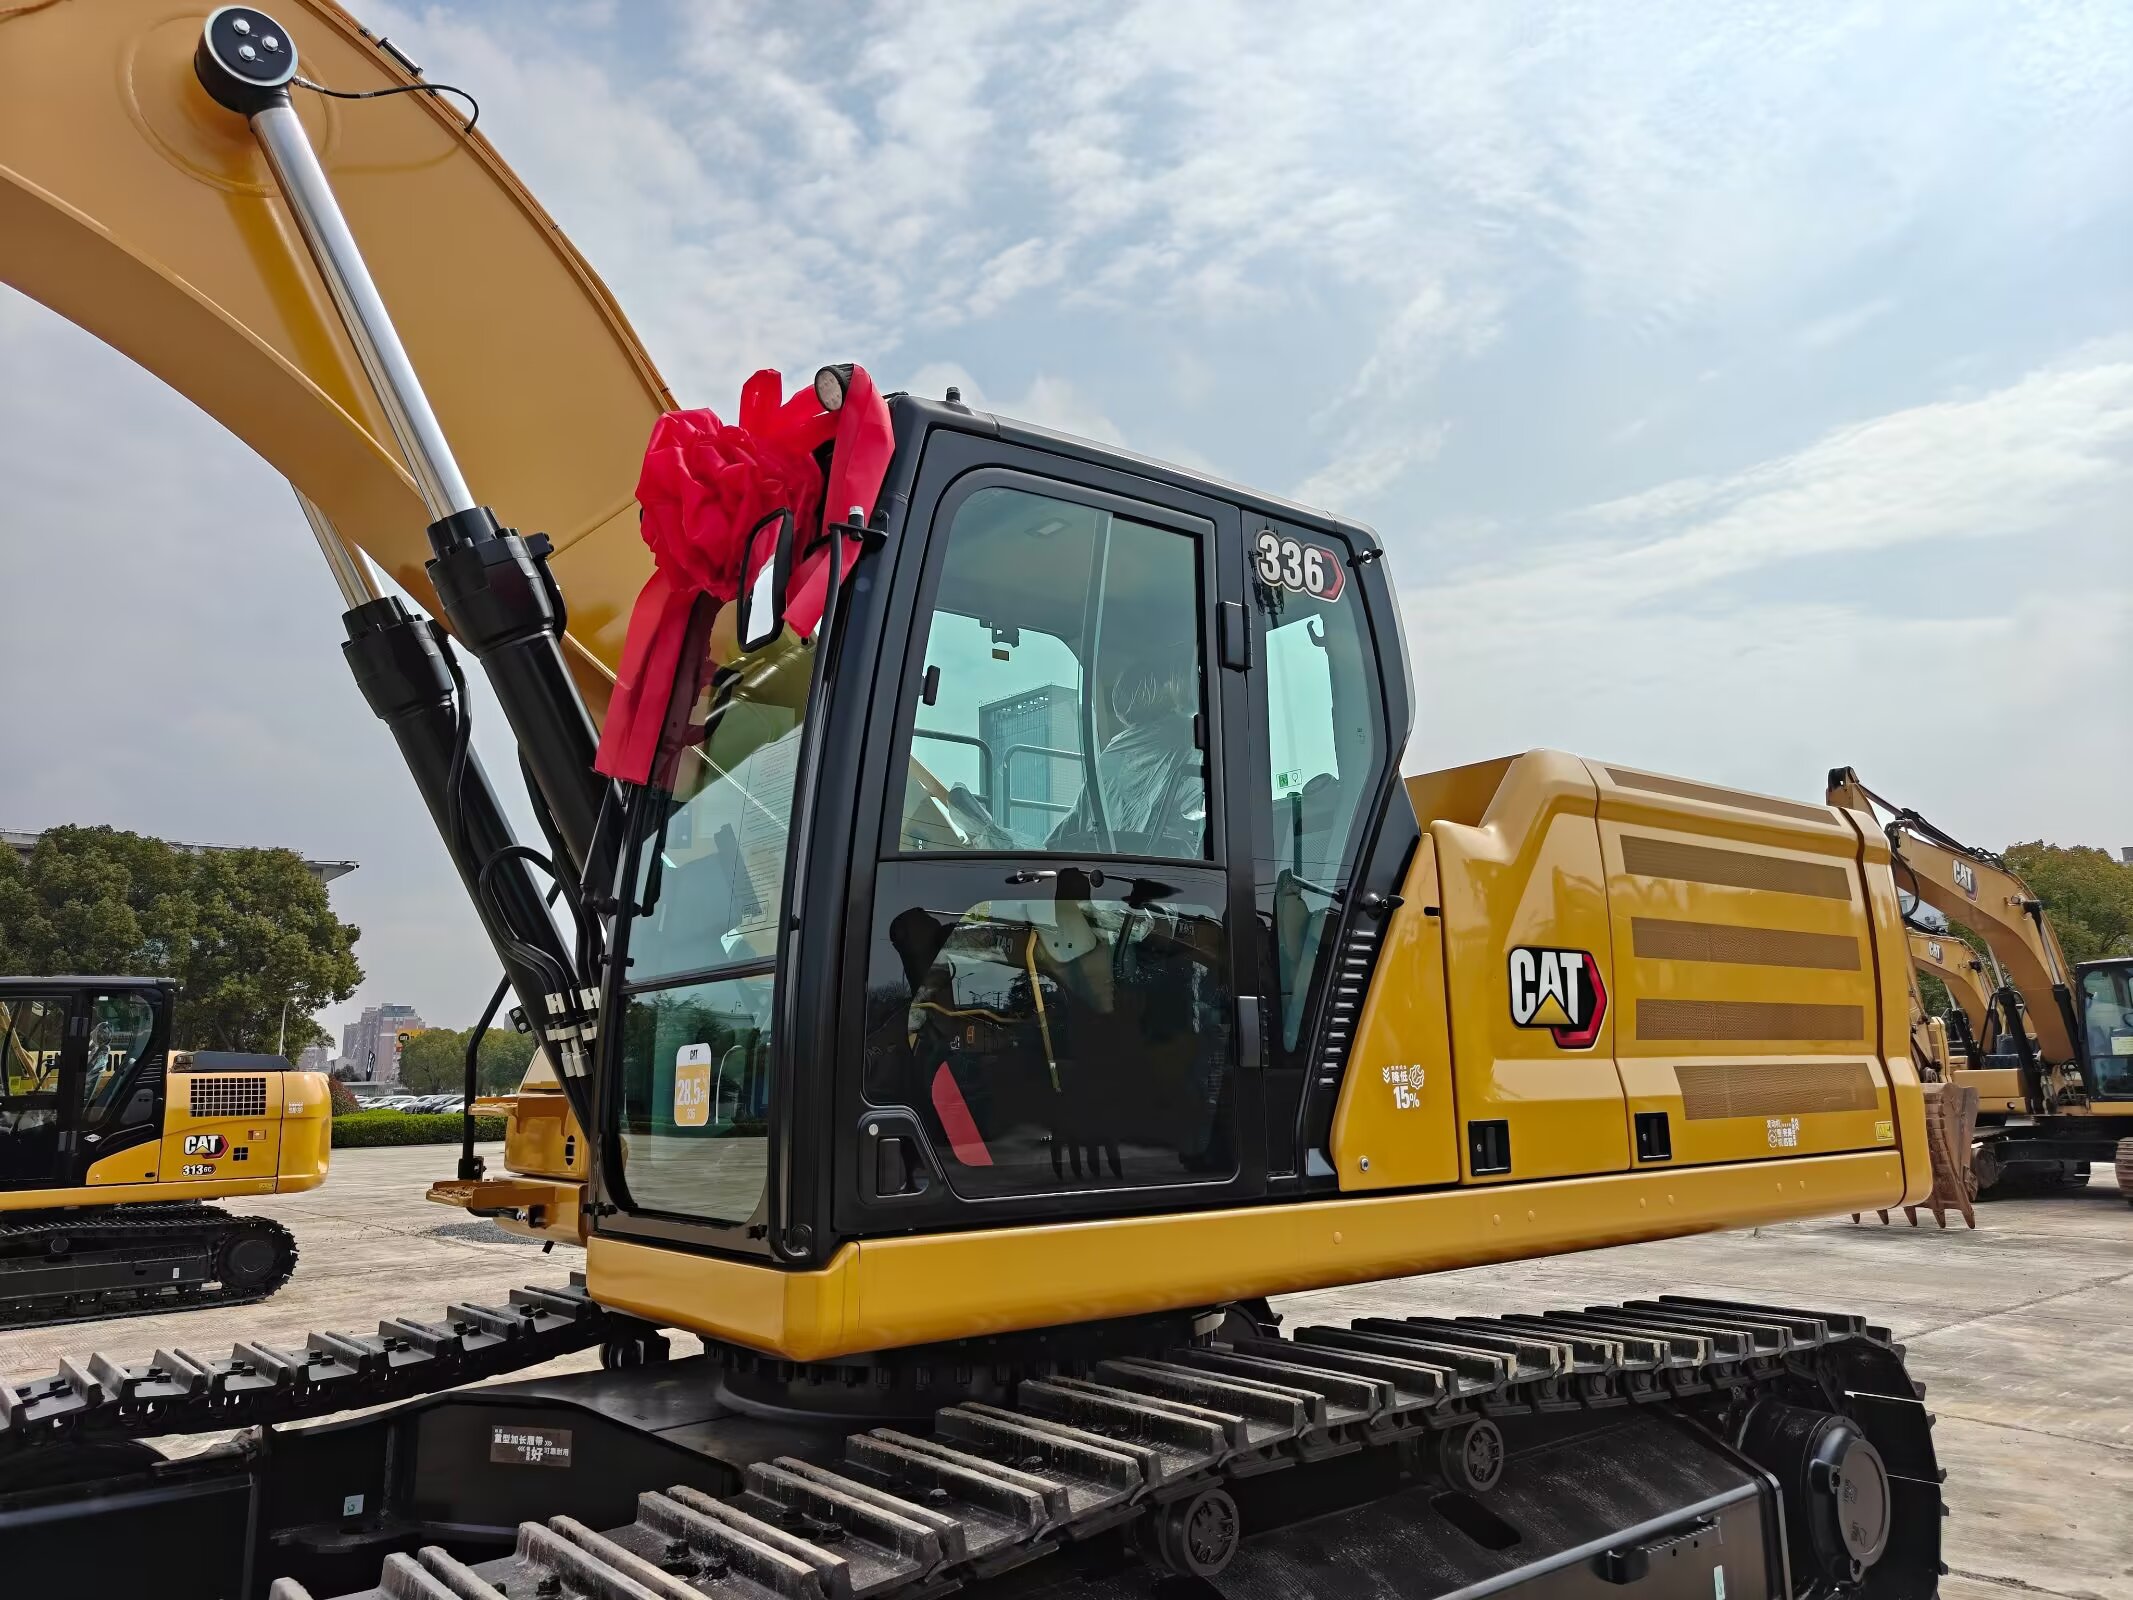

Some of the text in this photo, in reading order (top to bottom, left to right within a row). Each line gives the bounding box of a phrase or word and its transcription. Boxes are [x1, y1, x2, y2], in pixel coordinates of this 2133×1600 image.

[1259, 534, 1324, 593] 336
[1952, 859, 1973, 892] CAT
[1928, 941, 1941, 960] CAT
[1510, 948, 1583, 1025] CAT
[689, 1049, 699, 1060] CAT
[677, 1079, 701, 1105] 28.5
[1393, 1086, 1420, 1109] 15%
[185, 1135, 219, 1155] CAT
[182, 1164, 204, 1176] 313
[494, 1433, 543, 1446] 重型加长履带
[531, 1446, 543, 1462] 好
